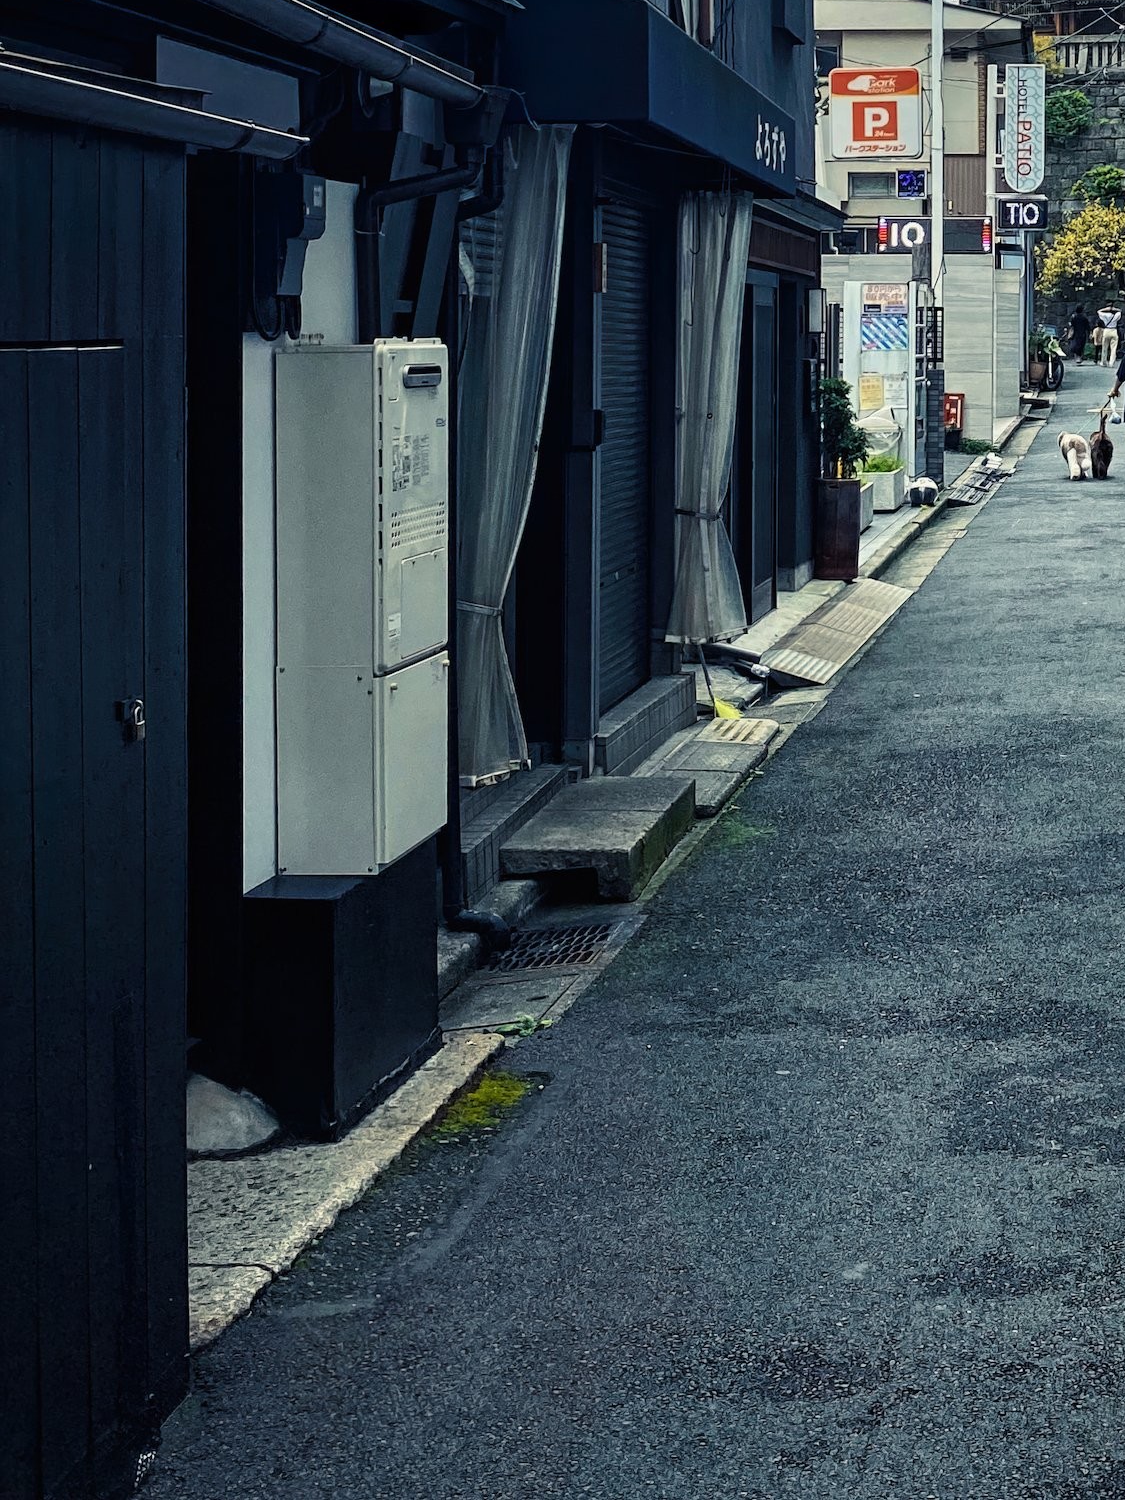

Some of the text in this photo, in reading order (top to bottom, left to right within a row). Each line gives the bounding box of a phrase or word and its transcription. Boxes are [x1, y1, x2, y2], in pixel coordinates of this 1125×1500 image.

[863, 106, 890, 138] P
[1017, 79, 1032, 176] HOTEL PATIO
[844, 143, 907, 153] パークステーション
